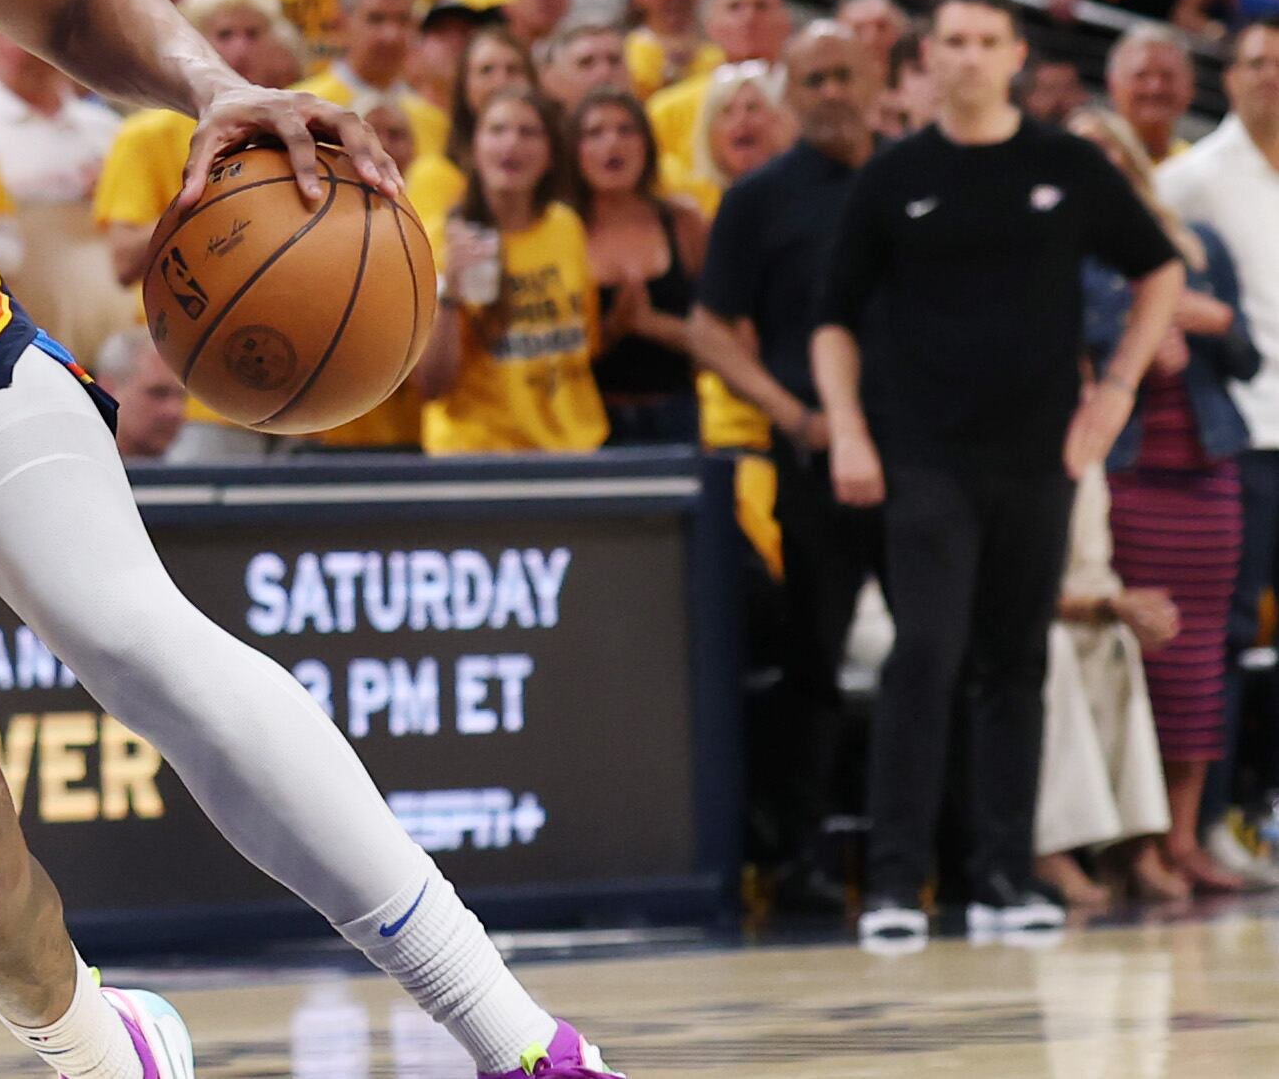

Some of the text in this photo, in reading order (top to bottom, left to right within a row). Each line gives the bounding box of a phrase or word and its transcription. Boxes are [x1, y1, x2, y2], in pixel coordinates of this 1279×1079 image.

[245, 546, 573, 635] SATURDAY
[347, 656, 441, 738] PM
[454, 652, 535, 735] ET
